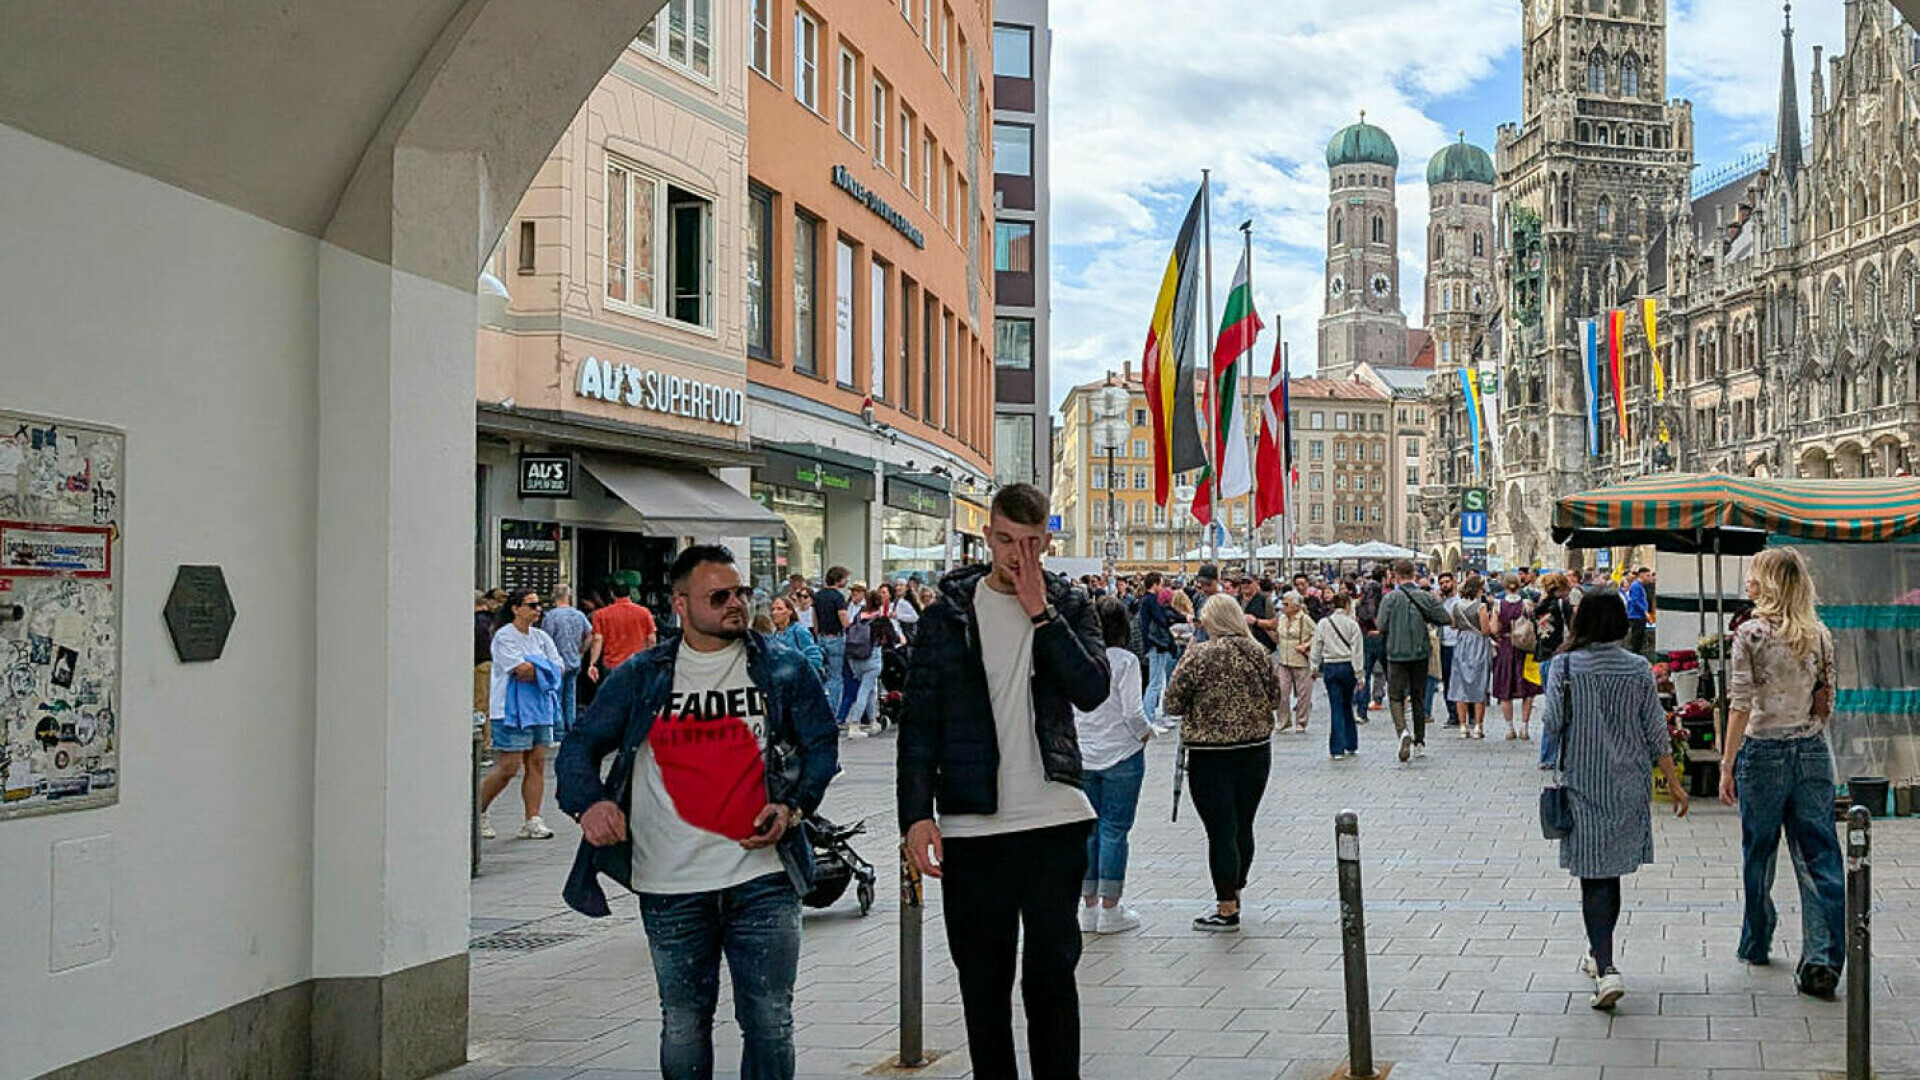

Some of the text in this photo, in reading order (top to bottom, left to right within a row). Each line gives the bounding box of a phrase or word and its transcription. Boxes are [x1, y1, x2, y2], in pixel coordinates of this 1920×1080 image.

[646, 369, 743, 426] SUPERFOOD
[1466, 490, 1483, 511] S
[1467, 513, 1482, 533] U
[662, 686, 767, 722] FADED
